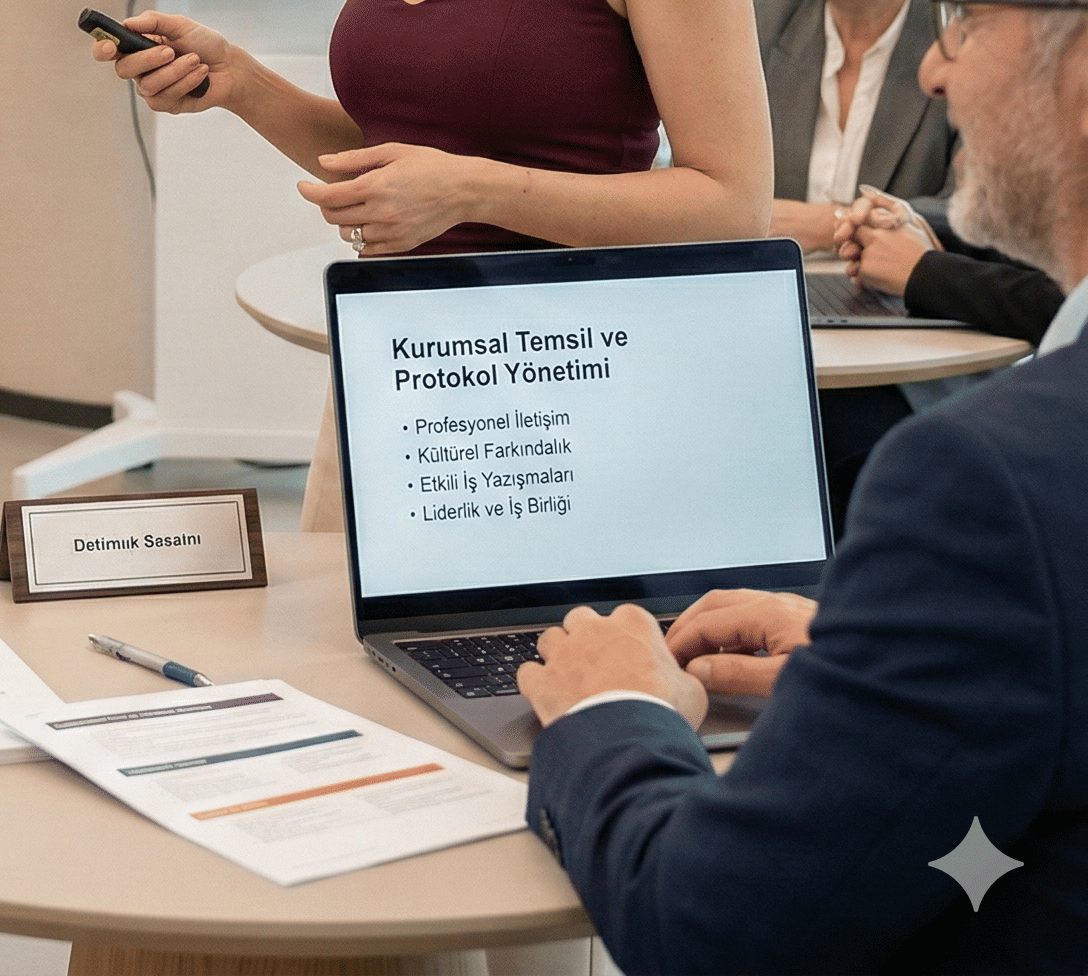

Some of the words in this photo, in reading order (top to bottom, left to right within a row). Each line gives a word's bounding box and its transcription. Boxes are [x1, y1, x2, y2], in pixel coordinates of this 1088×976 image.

[391, 331, 509, 360] Kurumsal
[514, 326, 594, 353] Temsil
[599, 330, 628, 348] ve
[394, 363, 498, 392] Protokol
[503, 356, 611, 385] Yönetimi
[415, 412, 511, 437] Profesyonel
[514, 408, 571, 432] İletişim
[417, 443, 480, 465] Kültürel
[483, 437, 573, 460] Farkındalık
[419, 473, 459, 493] Etkili
[463, 469, 478, 494] İş
[480, 466, 574, 491] Yazışmaları
[422, 501, 481, 522] Liderlik
[484, 503, 505, 517] ve
[508, 495, 524, 520] İş
[527, 494, 572, 516] Birliği
